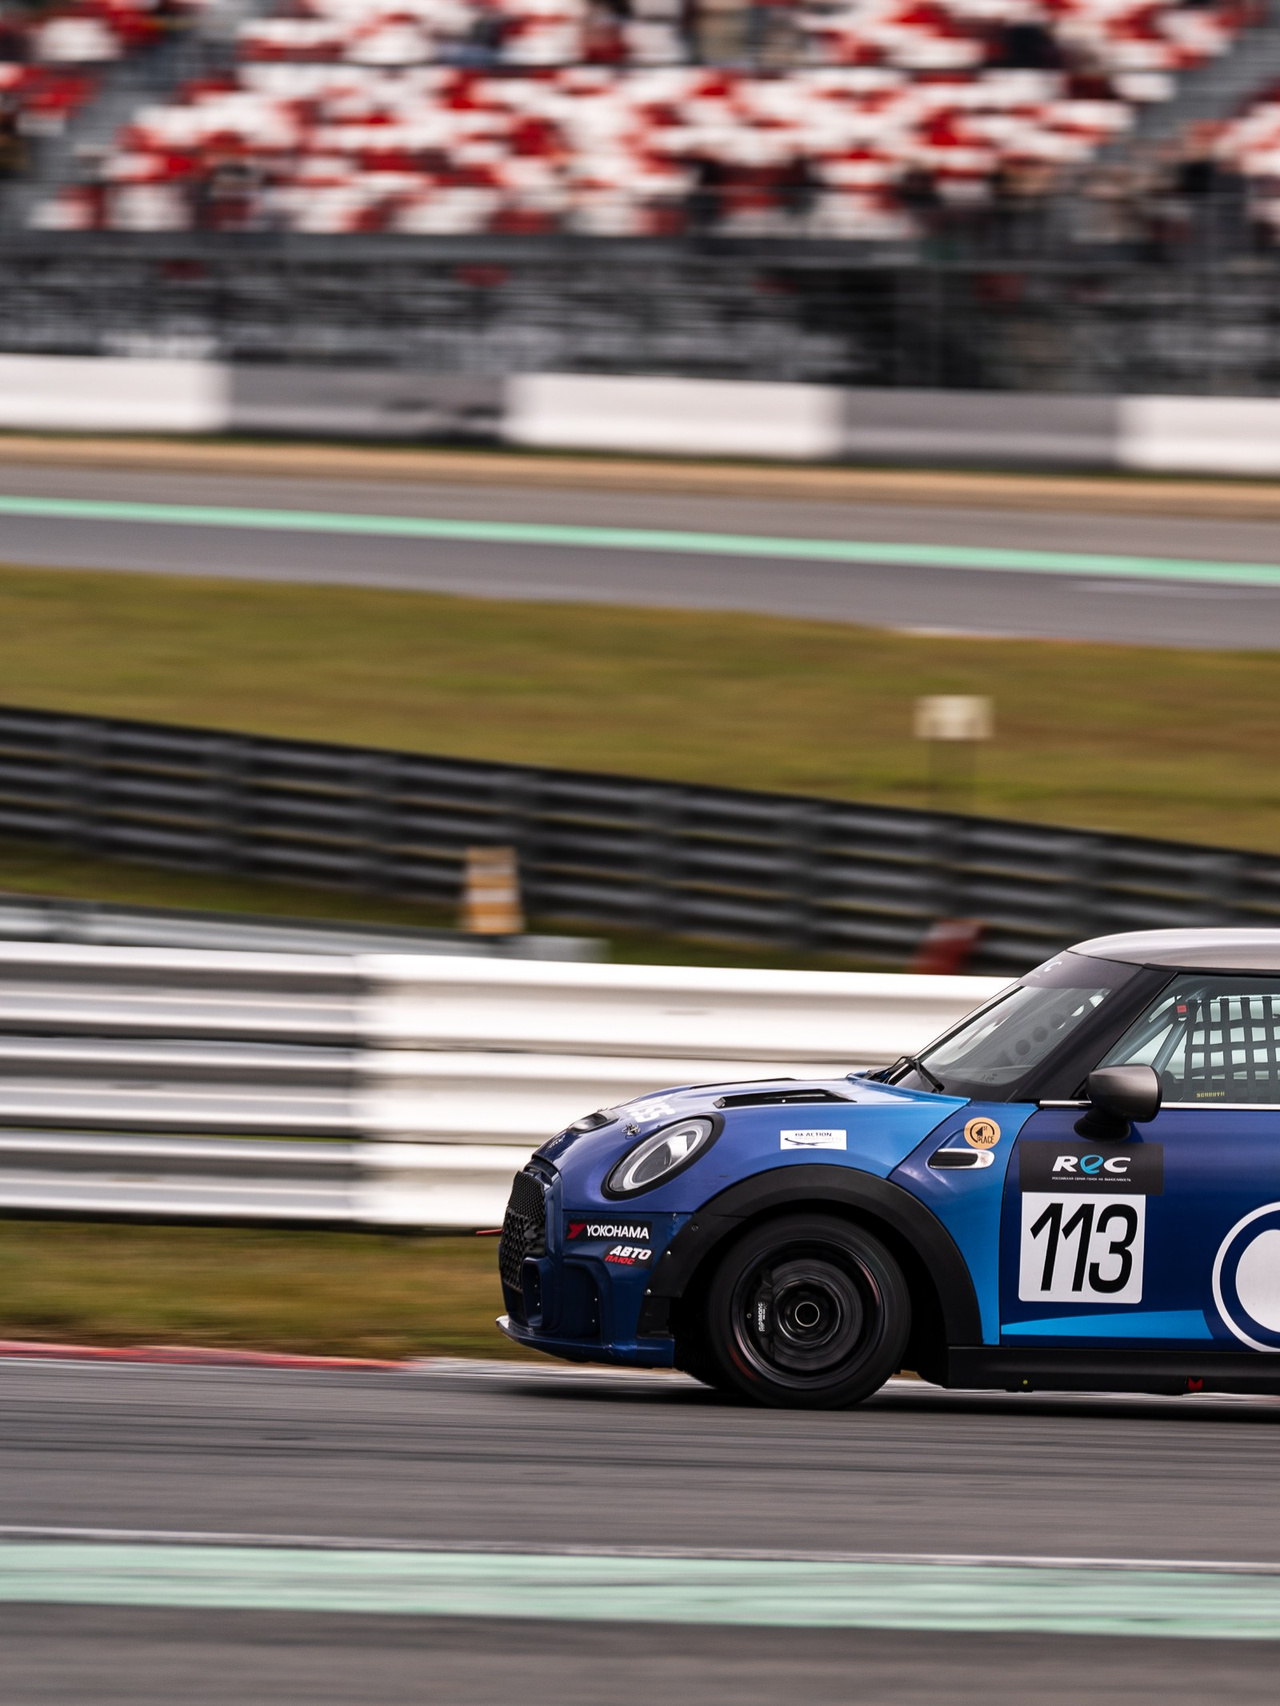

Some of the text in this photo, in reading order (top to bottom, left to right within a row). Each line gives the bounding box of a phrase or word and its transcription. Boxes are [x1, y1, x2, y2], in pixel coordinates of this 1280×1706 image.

[586, 1224, 650, 1240] YOKOHAMA
[609, 1245, 652, 1260] АВТО
[1030, 1202, 1138, 1294] 113
